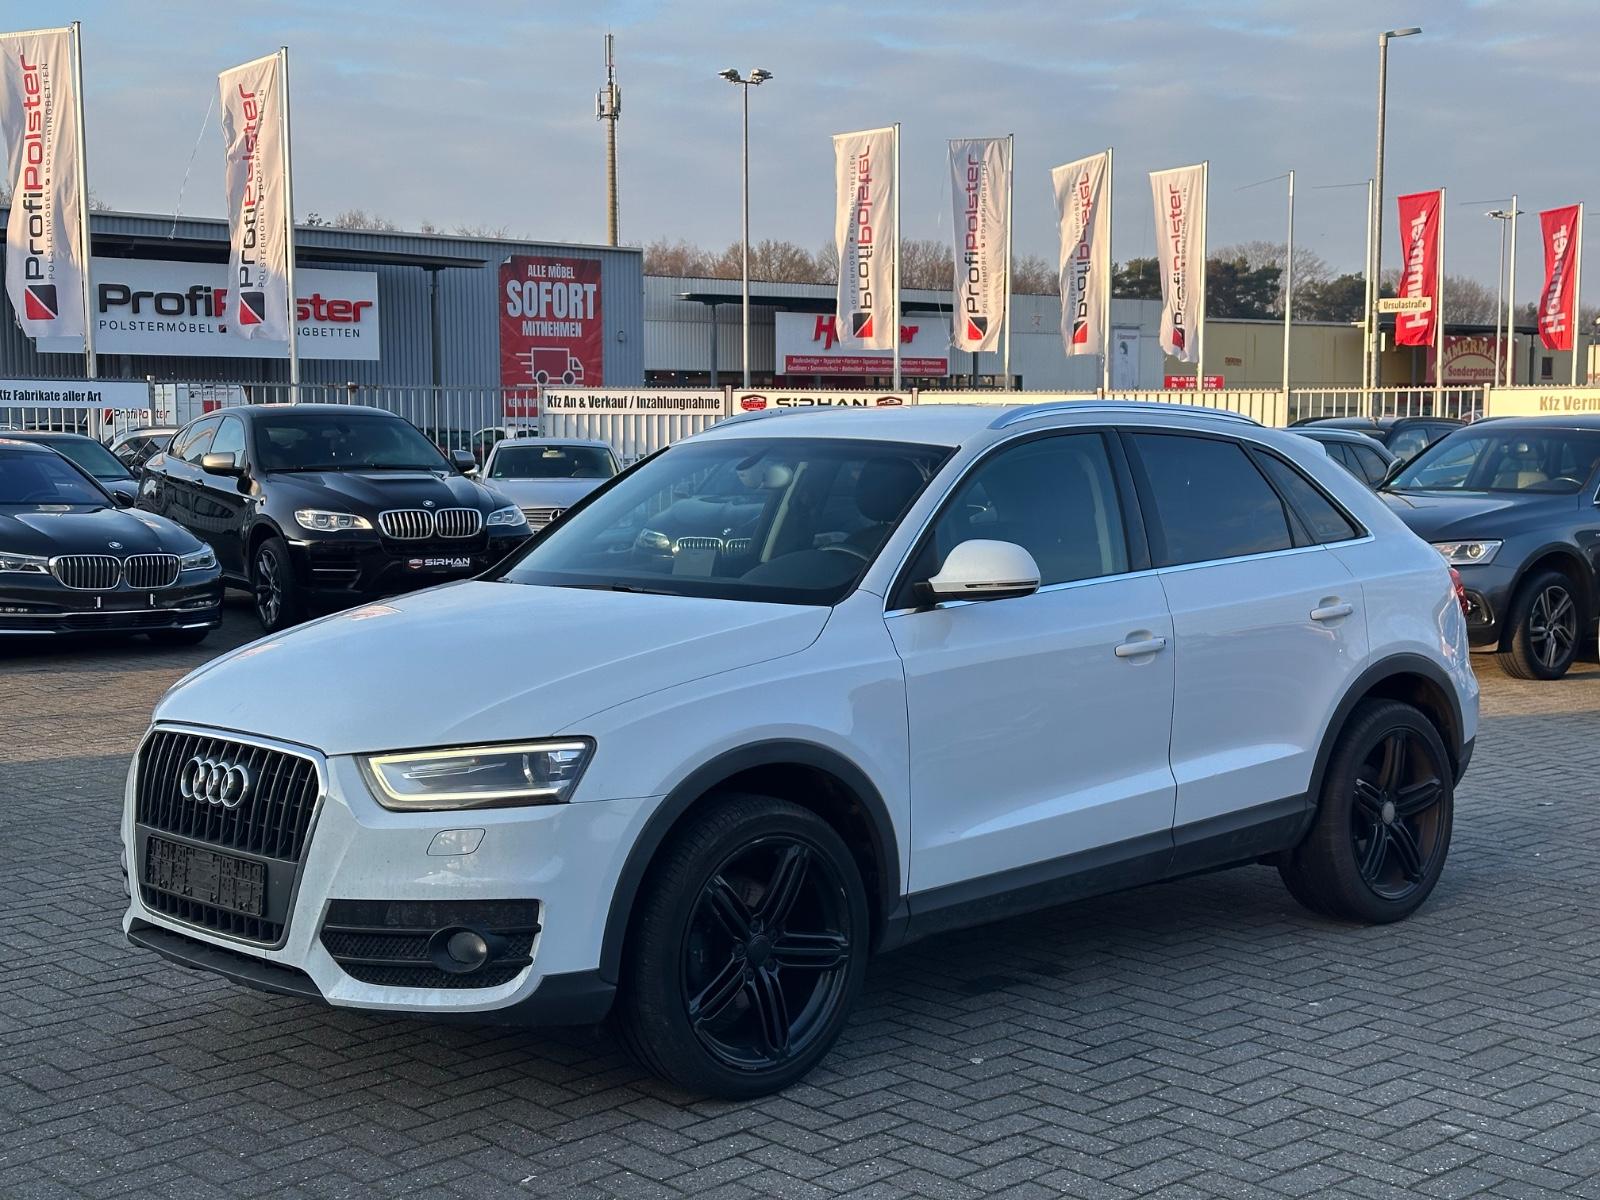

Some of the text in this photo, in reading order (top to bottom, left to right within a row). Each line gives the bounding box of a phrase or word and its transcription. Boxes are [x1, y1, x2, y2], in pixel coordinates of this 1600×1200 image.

[20, 54, 44, 280] ProfiPolster
[964, 154, 980, 313] ProfiPolster
[528, 263, 575, 279] ALLE MÖBEL
[506, 279, 597, 320] SOFORT
[99, 320, 214, 334] POLSTERMÖBEL
[522, 321, 582, 337] MITNEHMEN
[13, 390, 61, 401] Fabrikate
[62, 390, 86, 402] aller
[87, 391, 102, 402] Art
[547, 395, 562, 409] Kfz
[564, 395, 576, 409] An
[579, 396, 586, 408] &
[588, 395, 628, 409] Verkauf
[637, 396, 720, 411] Inzahlungnahme
[1539, 395, 1560, 411] Kfz
